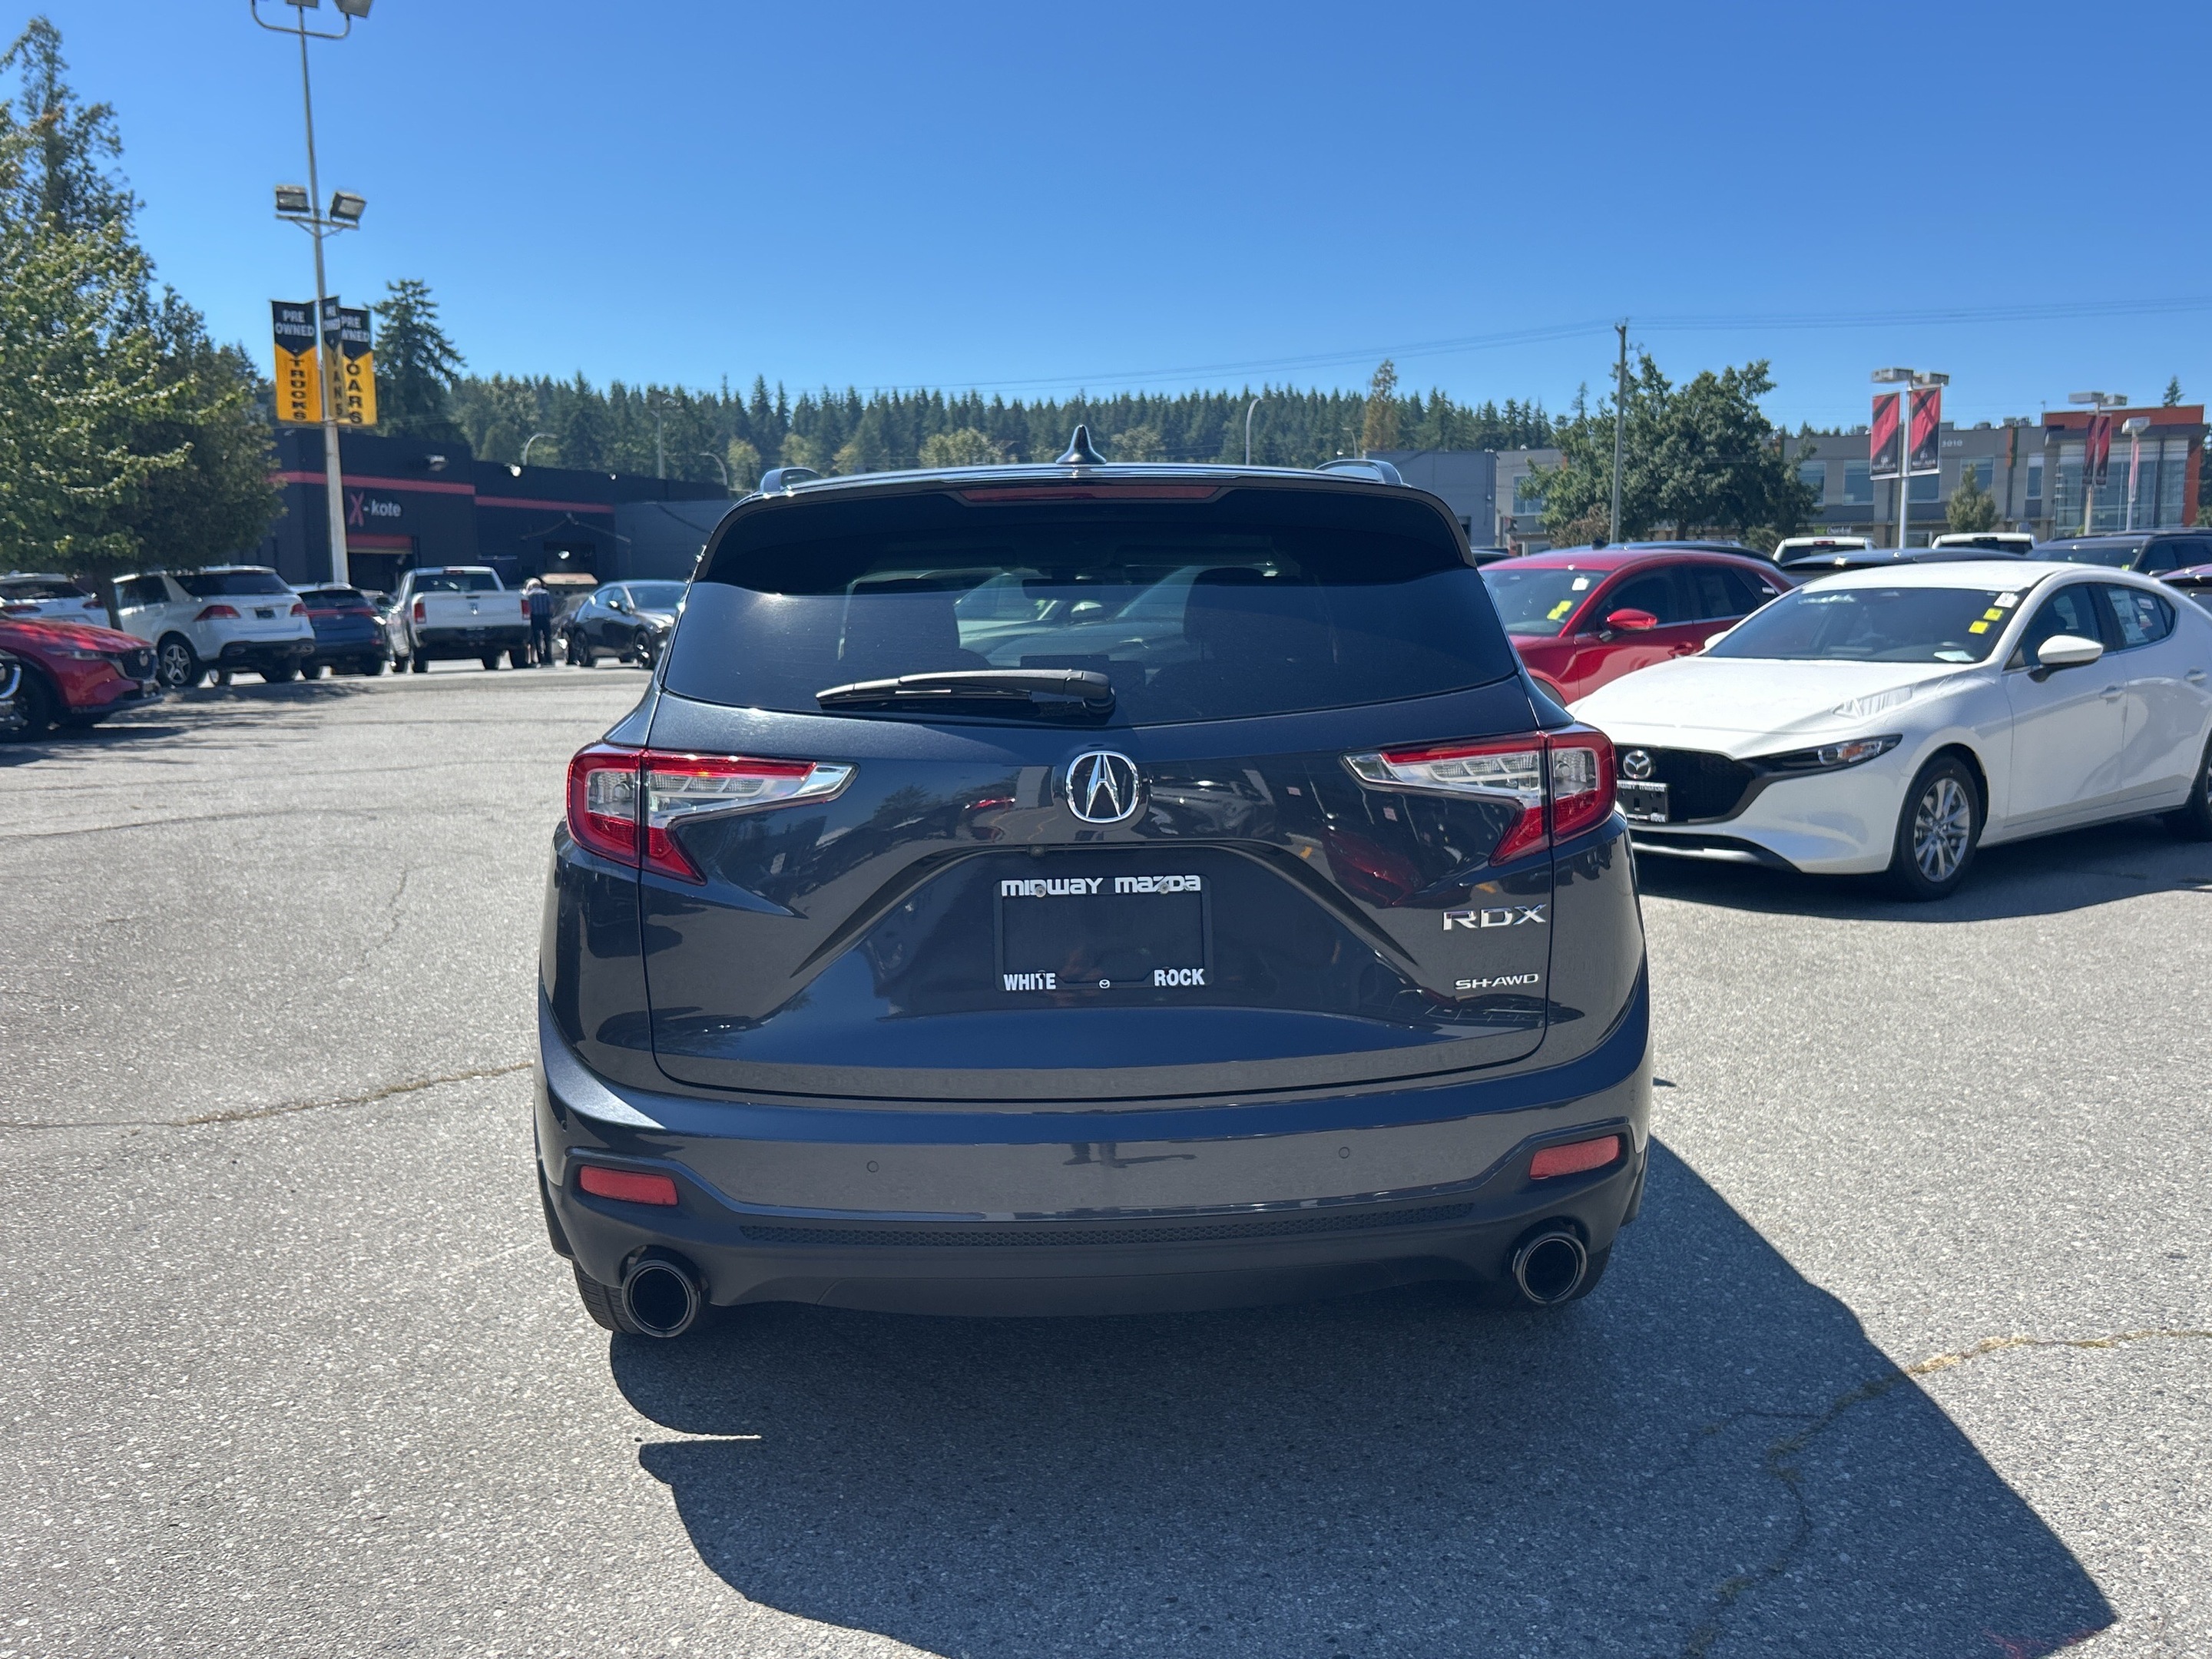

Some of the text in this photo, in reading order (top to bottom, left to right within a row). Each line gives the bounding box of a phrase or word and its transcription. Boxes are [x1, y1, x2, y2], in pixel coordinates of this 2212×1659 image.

[282, 309, 306, 323] PRE
[341, 314, 361, 329] PRE
[274, 323, 315, 337] OWNED
[1442, 903, 1547, 931] RDX
[1003, 969, 1205, 991] WHITE ROCK
[1455, 973, 1539, 990] SH-AWD
